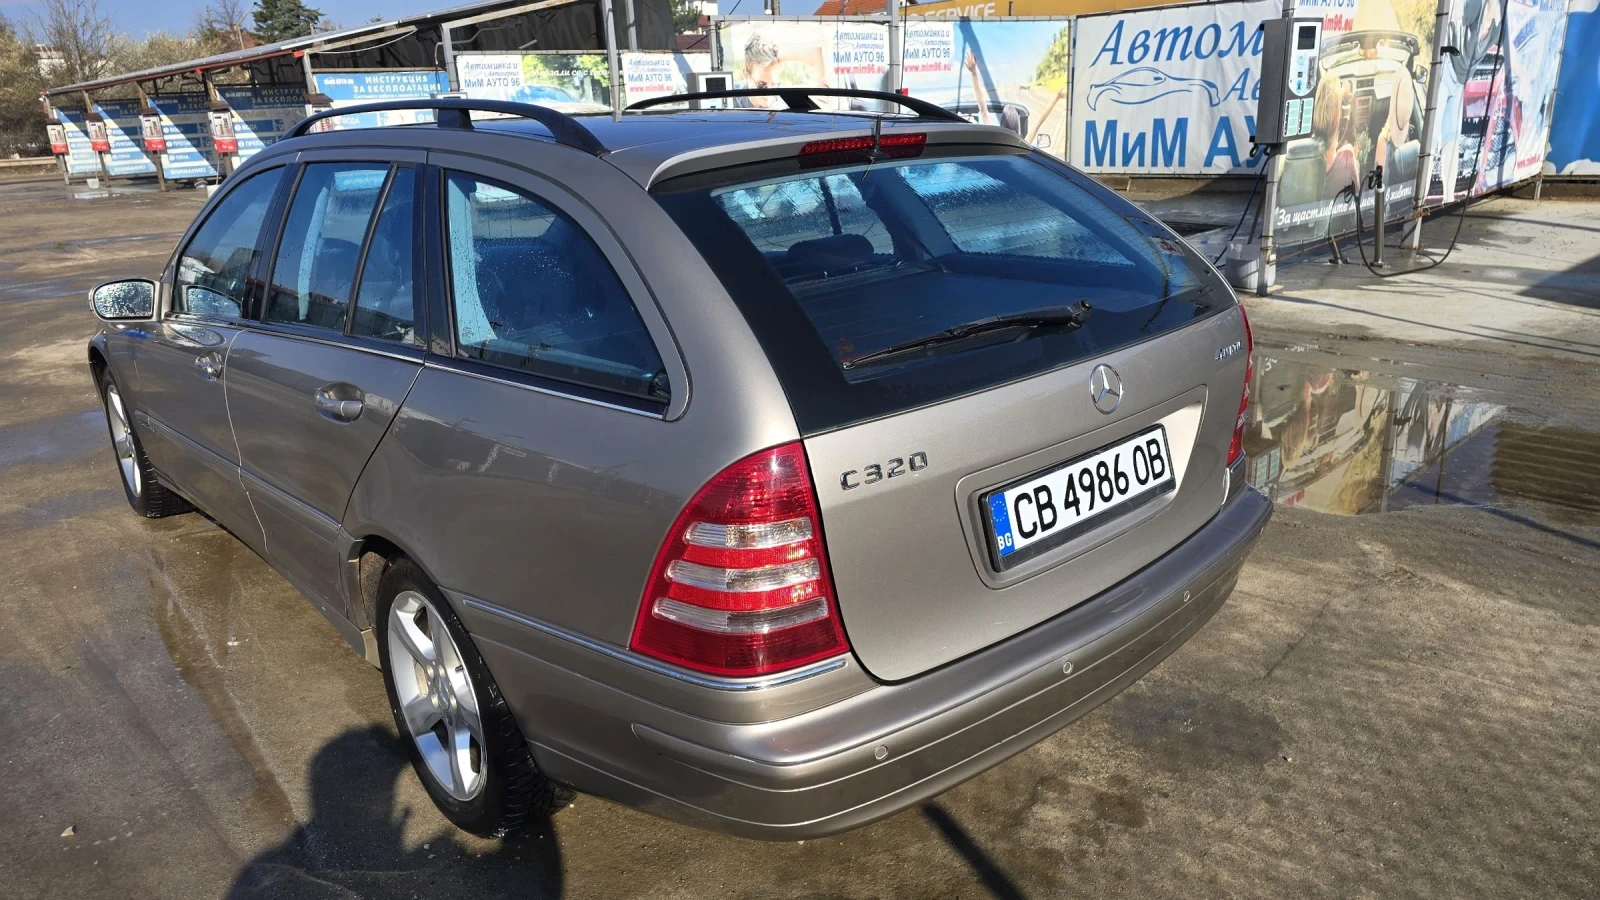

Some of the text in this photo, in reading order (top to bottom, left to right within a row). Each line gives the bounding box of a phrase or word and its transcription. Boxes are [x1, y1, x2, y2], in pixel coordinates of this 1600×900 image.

[833, 52, 884, 62] МиМ АУТО 96
[365, 75, 428, 84] ИНСТРУКЦИЯ
[464, 78, 520, 88] МиМ АУТО 96
[1084, 117, 1188, 167] МиМ
[840, 452, 927, 490] C320
[1014, 438, 1165, 539] CB 4986 OB
[997, 533, 1013, 550] BG
